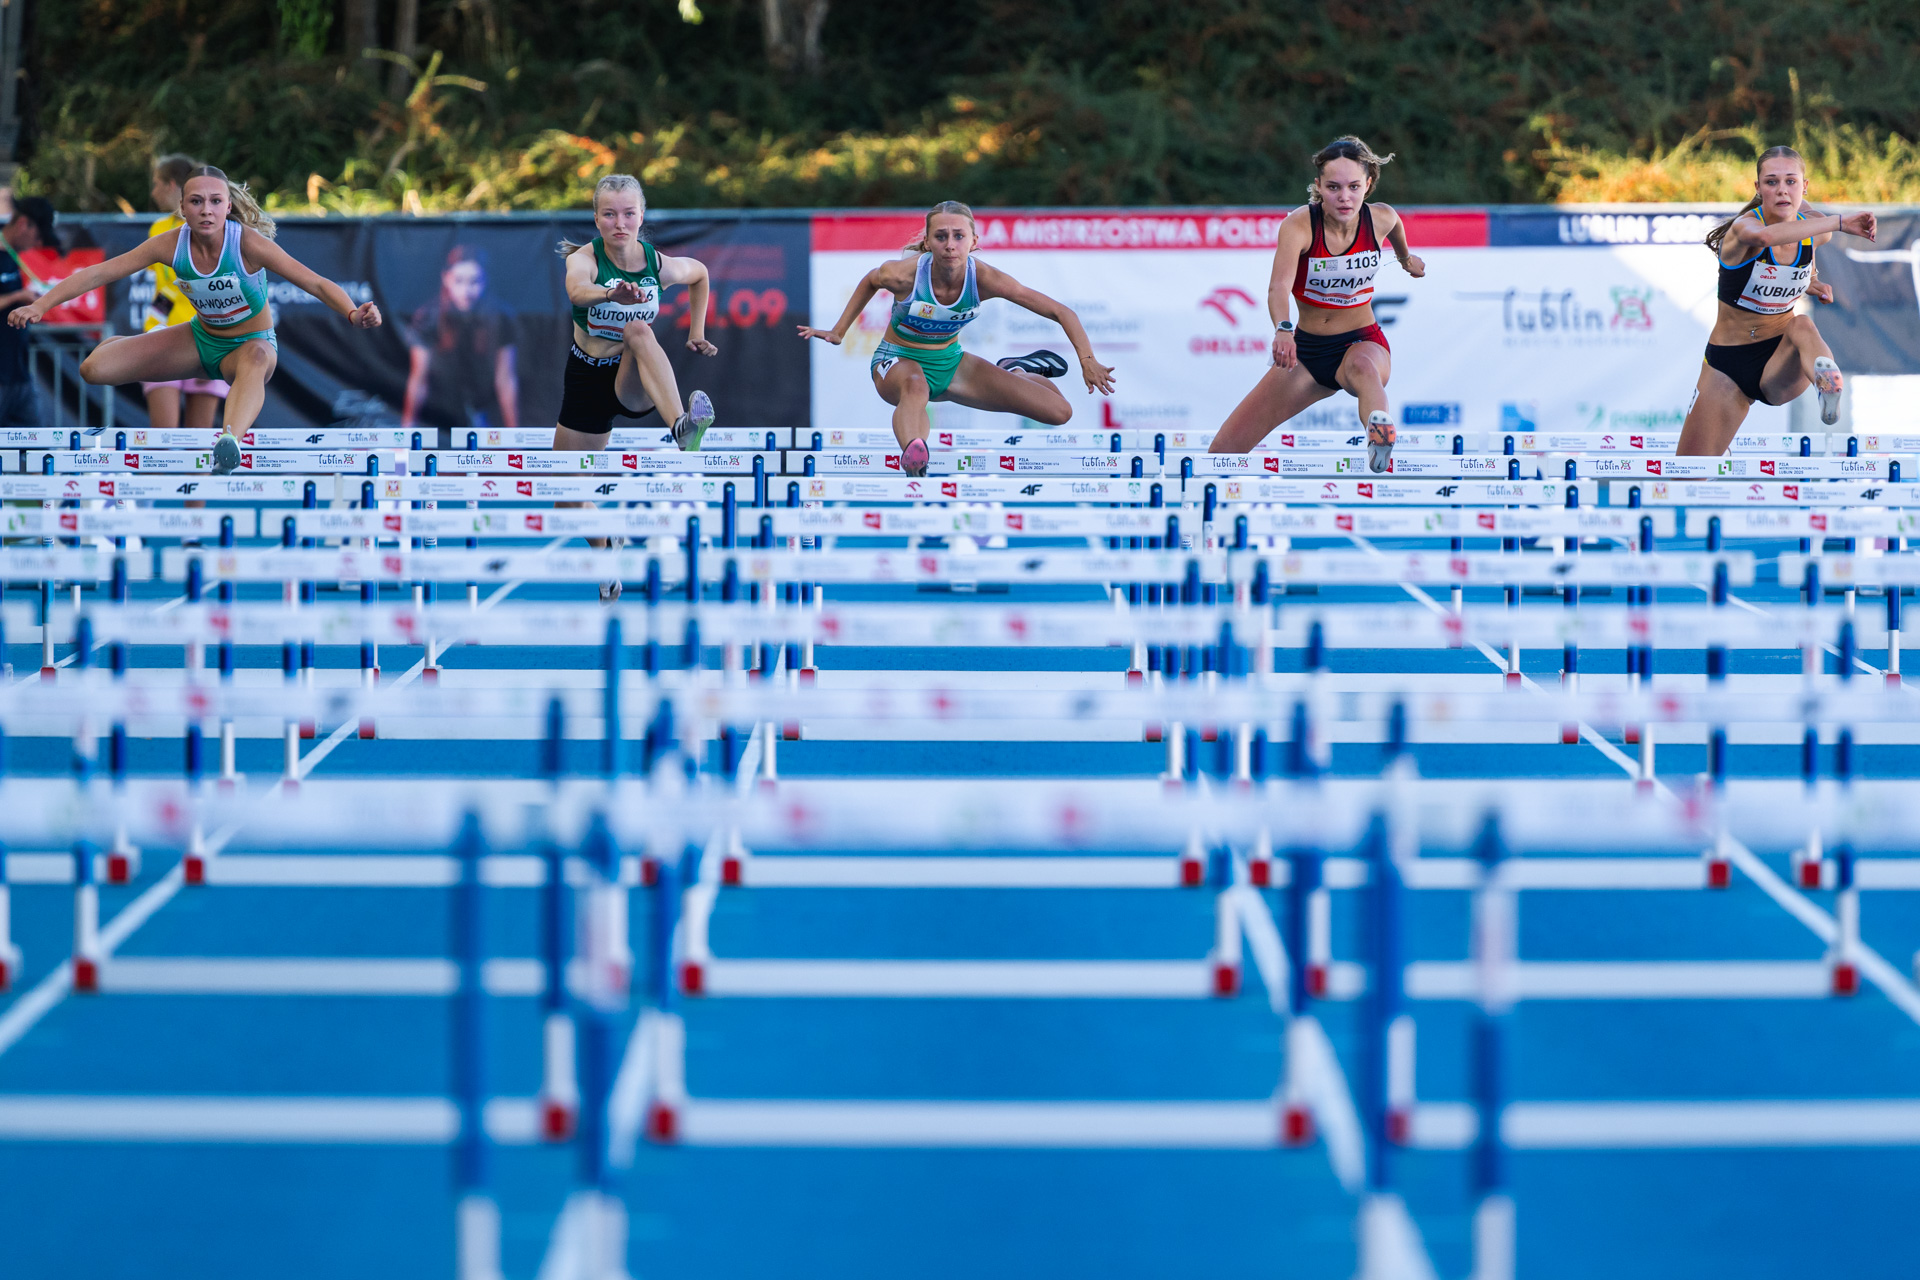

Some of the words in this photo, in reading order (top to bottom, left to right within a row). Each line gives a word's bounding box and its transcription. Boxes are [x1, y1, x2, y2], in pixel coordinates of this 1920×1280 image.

[1012, 218, 1202, 247] MISTRZOSTWA
[1206, 217, 1283, 246] POLS
[1558, 215, 1648, 243] LUBLIN
[1346, 255, 1378, 269] 1103
[208, 279, 234, 291] 604
[1309, 274, 1375, 289] GUZMAN
[1752, 284, 1806, 298] KUBIAK
[589, 306, 655, 322] DŁUTOWSKA
[600, 330, 620, 338] LUBLIN
[571, 343, 595, 366] NIKE
[597, 355, 621, 367] PR
[881, 360, 893, 372] 5
[305, 434, 325, 444] 4F
[1004, 435, 1023, 445] 4F
[1346, 436, 1365, 446] 4F
[74, 454, 98, 465] lublin
[319, 454, 343, 465] lublin
[457, 455, 481, 465] lublin
[704, 455, 728, 466] lublin
[834, 455, 858, 466] lublin
[1082, 457, 1106, 467] lublin
[1213, 457, 1237, 467] lublin
[1460, 459, 1484, 469] lublin
[1596, 460, 1619, 470] lublin
[1841, 461, 1865, 471] lublin
[176, 483, 199, 495] 4F
[595, 483, 618, 495] 4F
[1020, 484, 1043, 496] 4F
[1435, 485, 1458, 497] 4F
[1860, 488, 1883, 500] 4F
